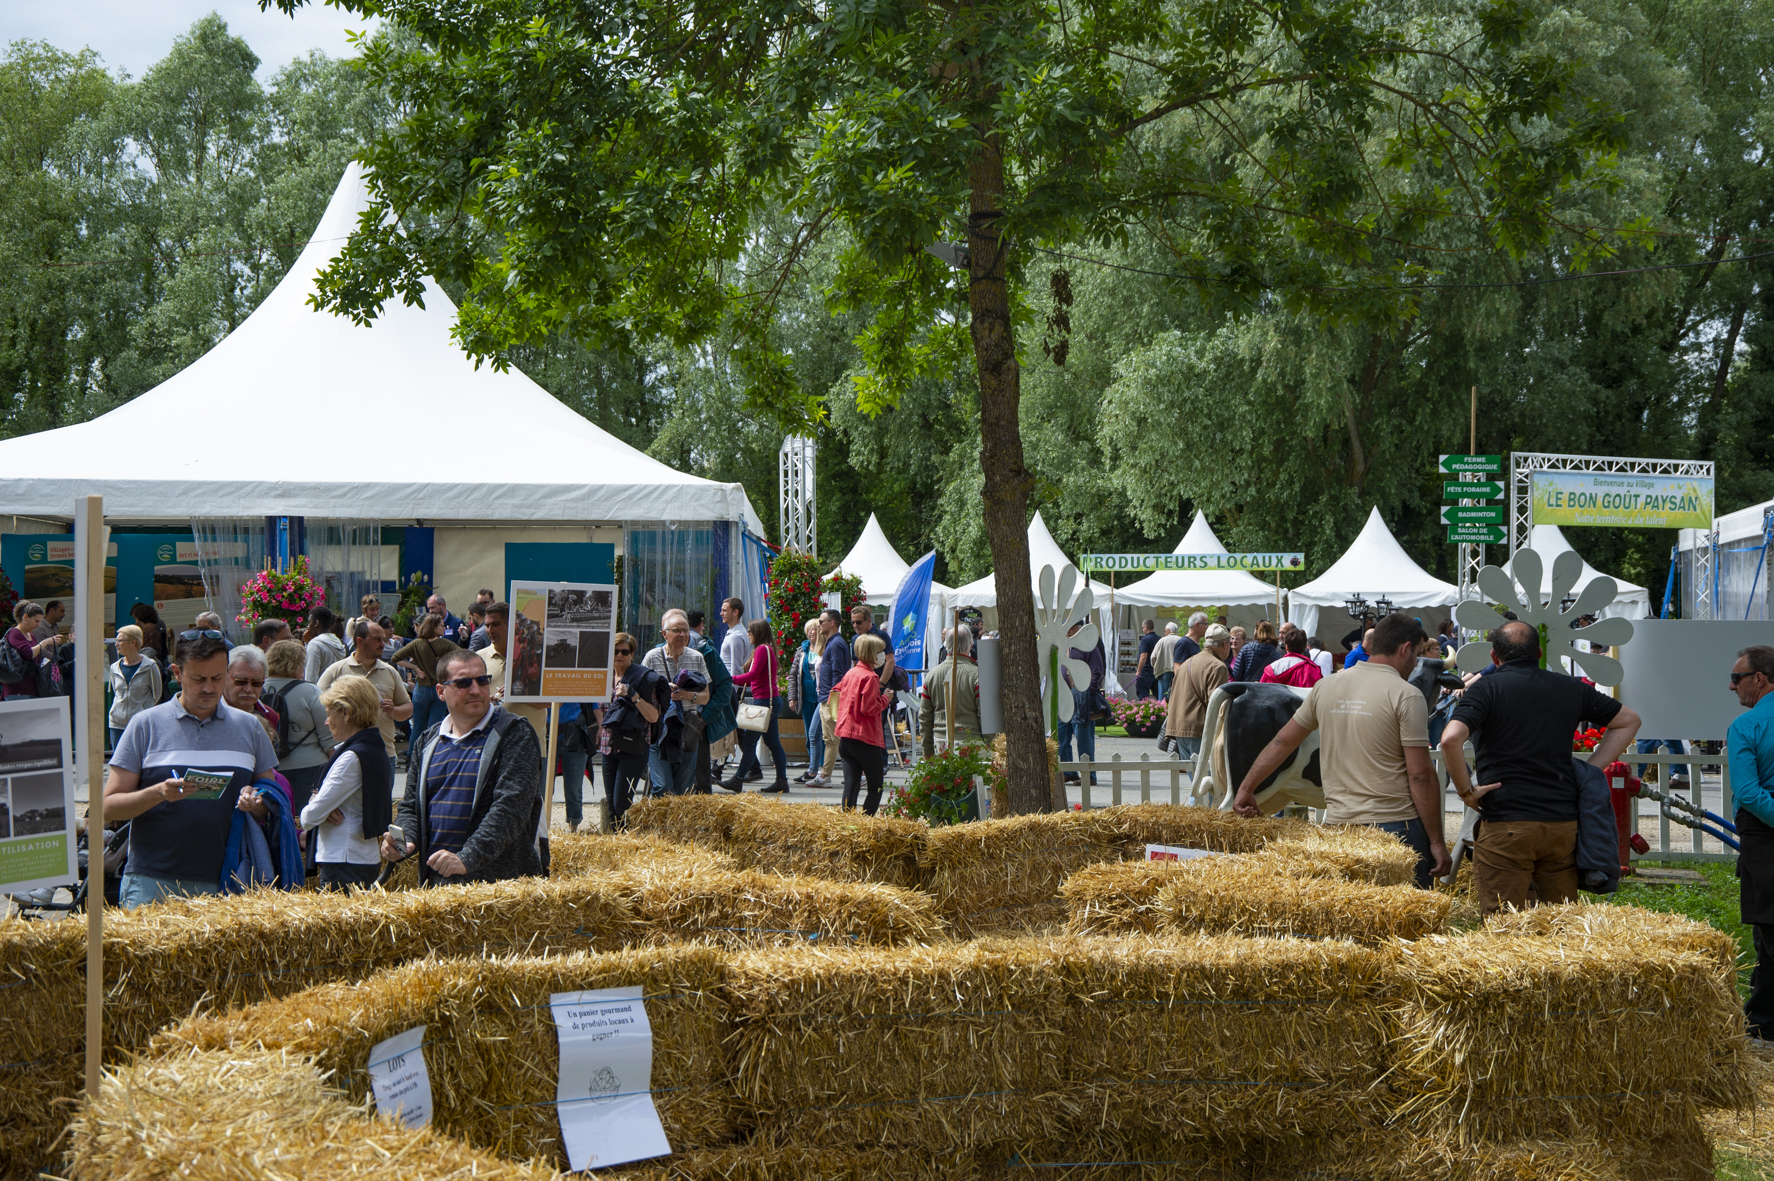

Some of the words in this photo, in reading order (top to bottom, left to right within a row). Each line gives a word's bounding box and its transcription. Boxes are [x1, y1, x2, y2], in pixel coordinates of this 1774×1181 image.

[1593, 477, 1625, 487] Bienvenue
[1635, 479, 1655, 490] Village
[1547, 490, 1564, 508] LE
[1567, 491, 1598, 509] BON
[1601, 489, 1641, 511] GOÛT
[1643, 494, 1698, 512] PAYSAN
[1574, 511, 1594, 523] Notre
[1597, 513, 1627, 524] territoire
[1634, 513, 1644, 524] du
[1645, 514, 1667, 525] talent
[49, 546, 70, 554] Villages
[1082, 555, 1208, 570] PRODUCTEURS
[1216, 554, 1285, 570] LOCAUX
[1, 839, 59, 855] TILISATION
[567, 1010, 577, 1018] Un
[578, 1008, 599, 1019] panier
[599, 1005, 632, 1016] gourmand
[572, 1022, 580, 1030] de
[581, 1019, 608, 1031] produits
[608, 1017, 629, 1026] locaux
[591, 1032, 613, 1042] gagner
[614, 1029, 620, 1038] !!
[387, 1054, 406, 1073] LOTS
